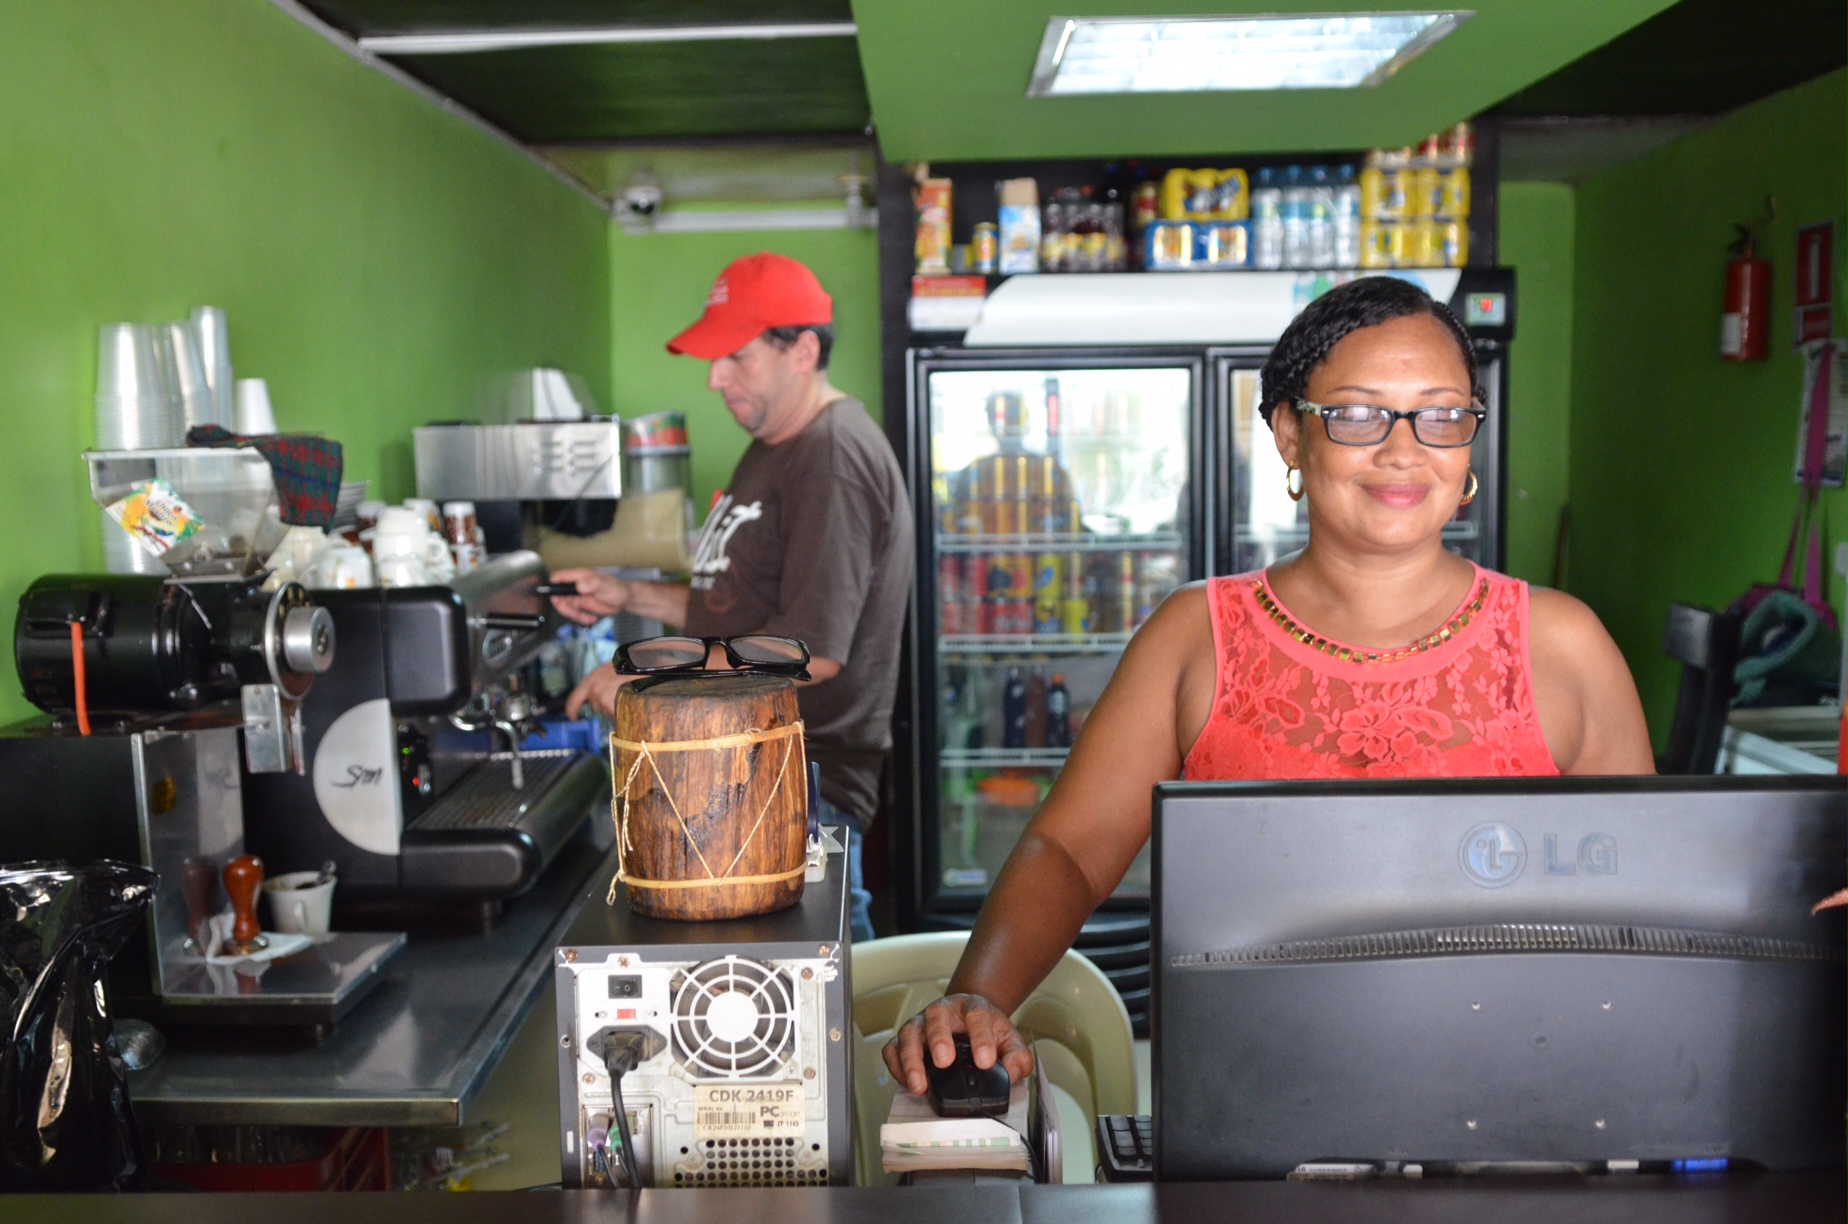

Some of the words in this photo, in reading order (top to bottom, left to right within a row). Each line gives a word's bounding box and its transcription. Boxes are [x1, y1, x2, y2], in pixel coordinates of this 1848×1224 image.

[1544, 832, 1618, 876] LG
[709, 1089, 742, 1103] CDK
[746, 1089, 794, 1103] 2419F
